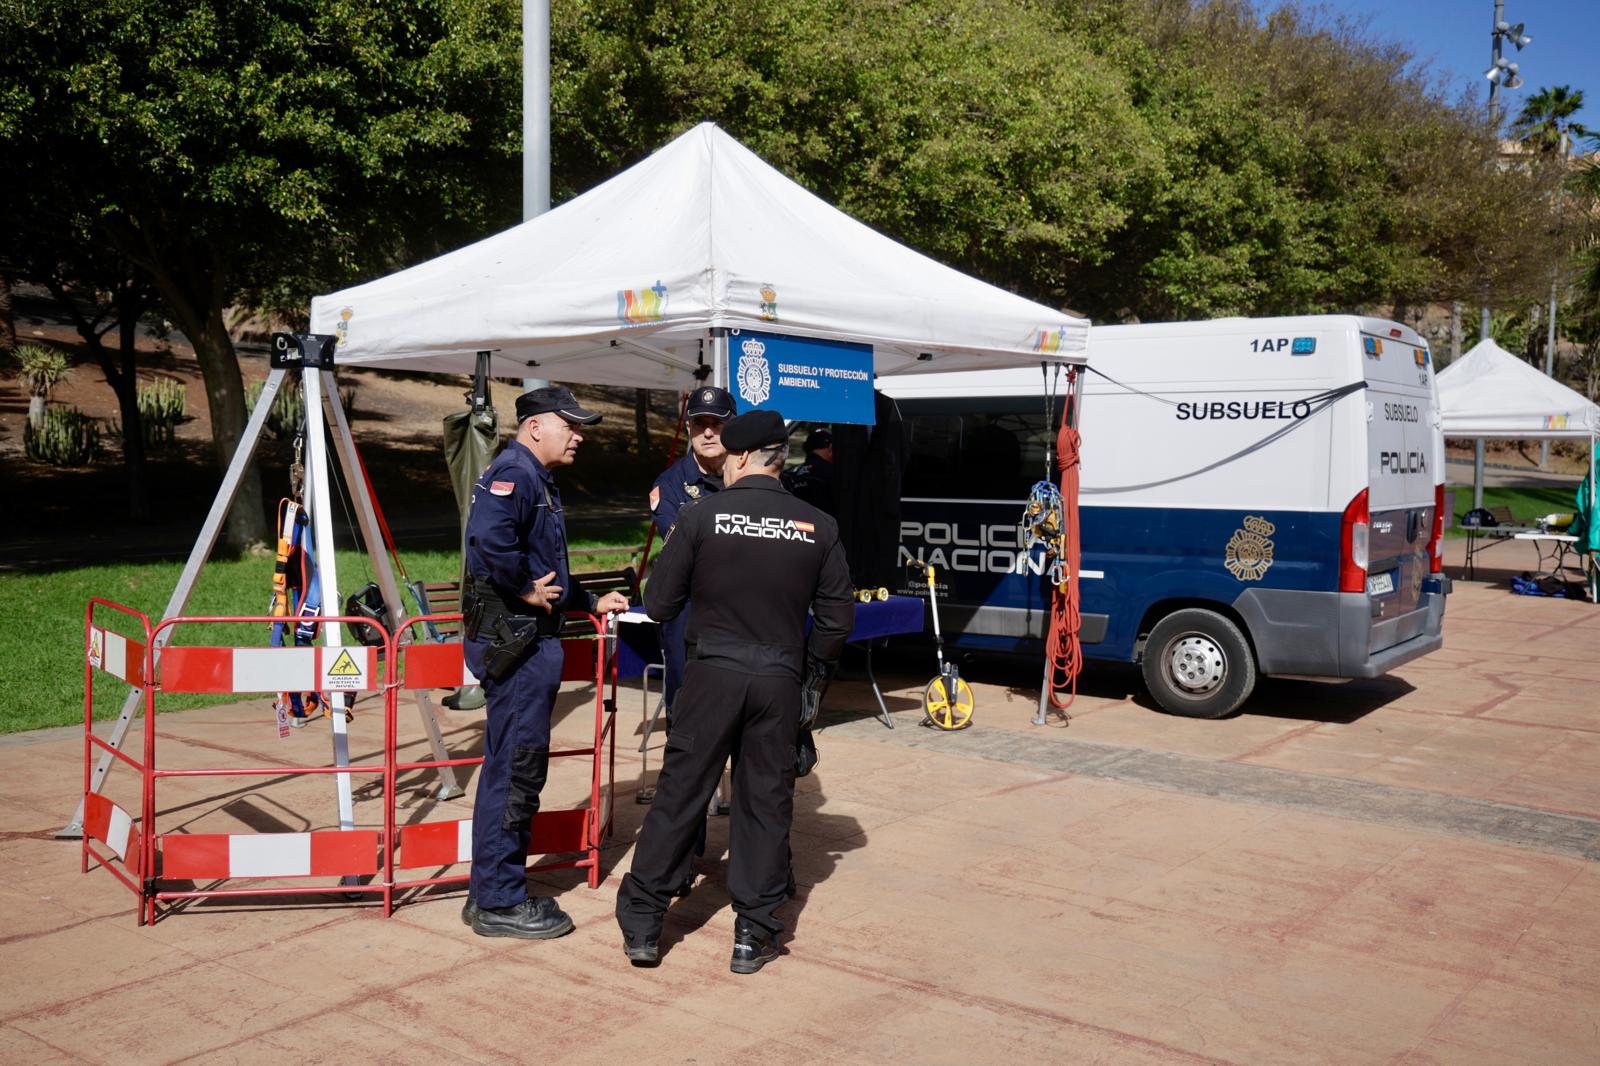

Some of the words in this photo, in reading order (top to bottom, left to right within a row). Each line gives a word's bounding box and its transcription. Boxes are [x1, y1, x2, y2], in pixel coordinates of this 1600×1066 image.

[1250, 338, 1289, 353] 1AP
[778, 363, 818, 376] SUBSUELO
[819, 367, 824, 377] Y
[825, 367, 868, 381] PROTECCIÓN
[778, 377, 820, 389] AMBIENTAL
[1175, 401, 1311, 421] SUBSUELO
[1384, 402, 1419, 423] SUBSUELO
[715, 513, 797, 530] POLICIA
[715, 524, 815, 544] NACIONAL
[897, 545, 1105, 578] NACION
[908, 580, 949, 590] @pocia
